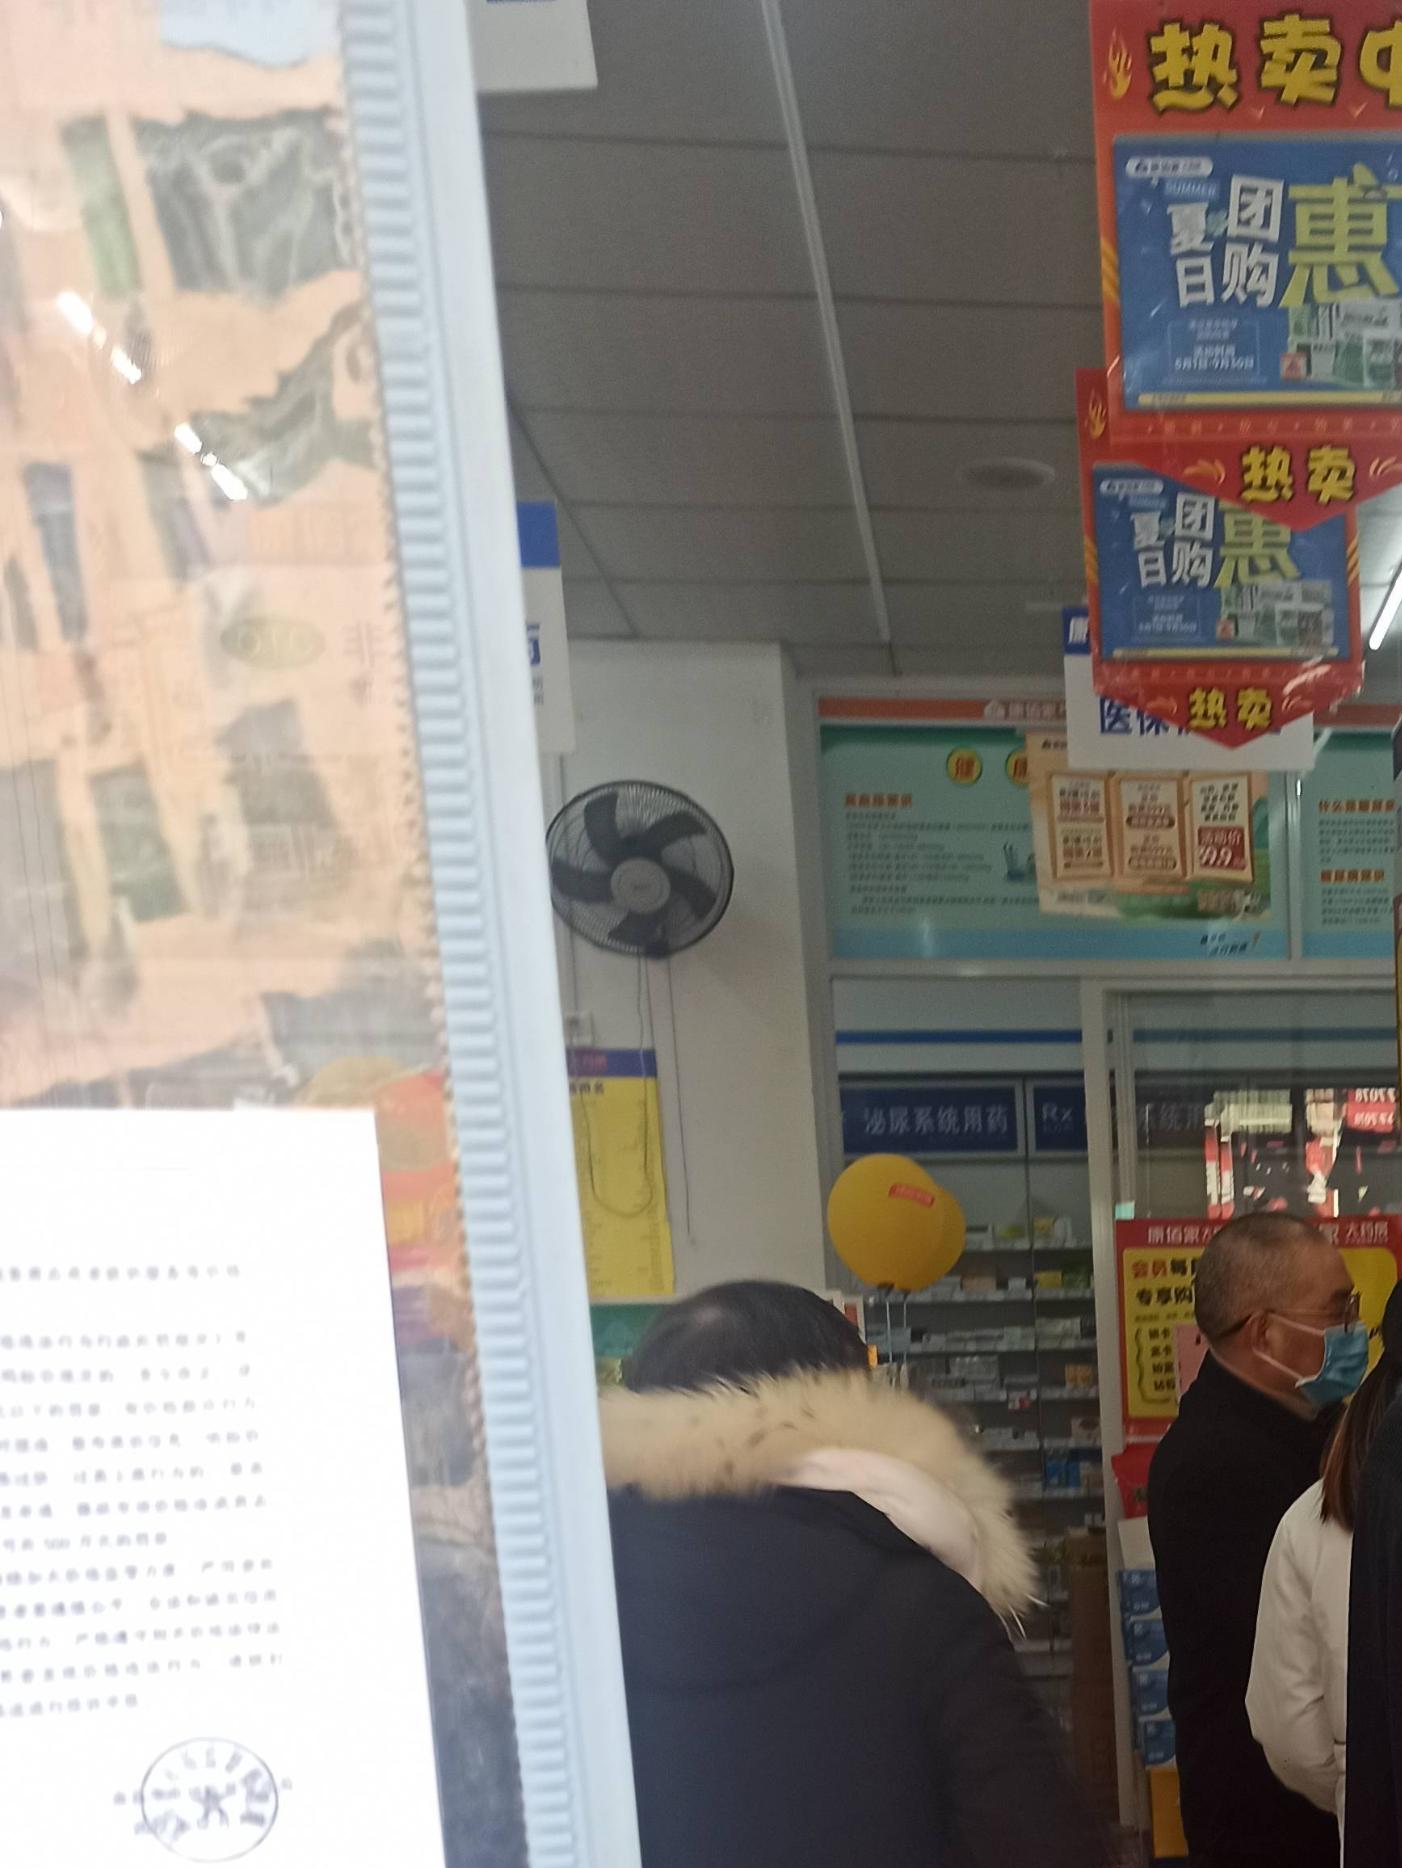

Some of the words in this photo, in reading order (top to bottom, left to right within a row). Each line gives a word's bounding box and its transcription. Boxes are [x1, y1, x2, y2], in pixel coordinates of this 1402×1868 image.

[1241, 445, 1356, 505] 热卖
[1188, 687, 1273, 730] 热卖
[1041, 1103, 1073, 1122] Rx
